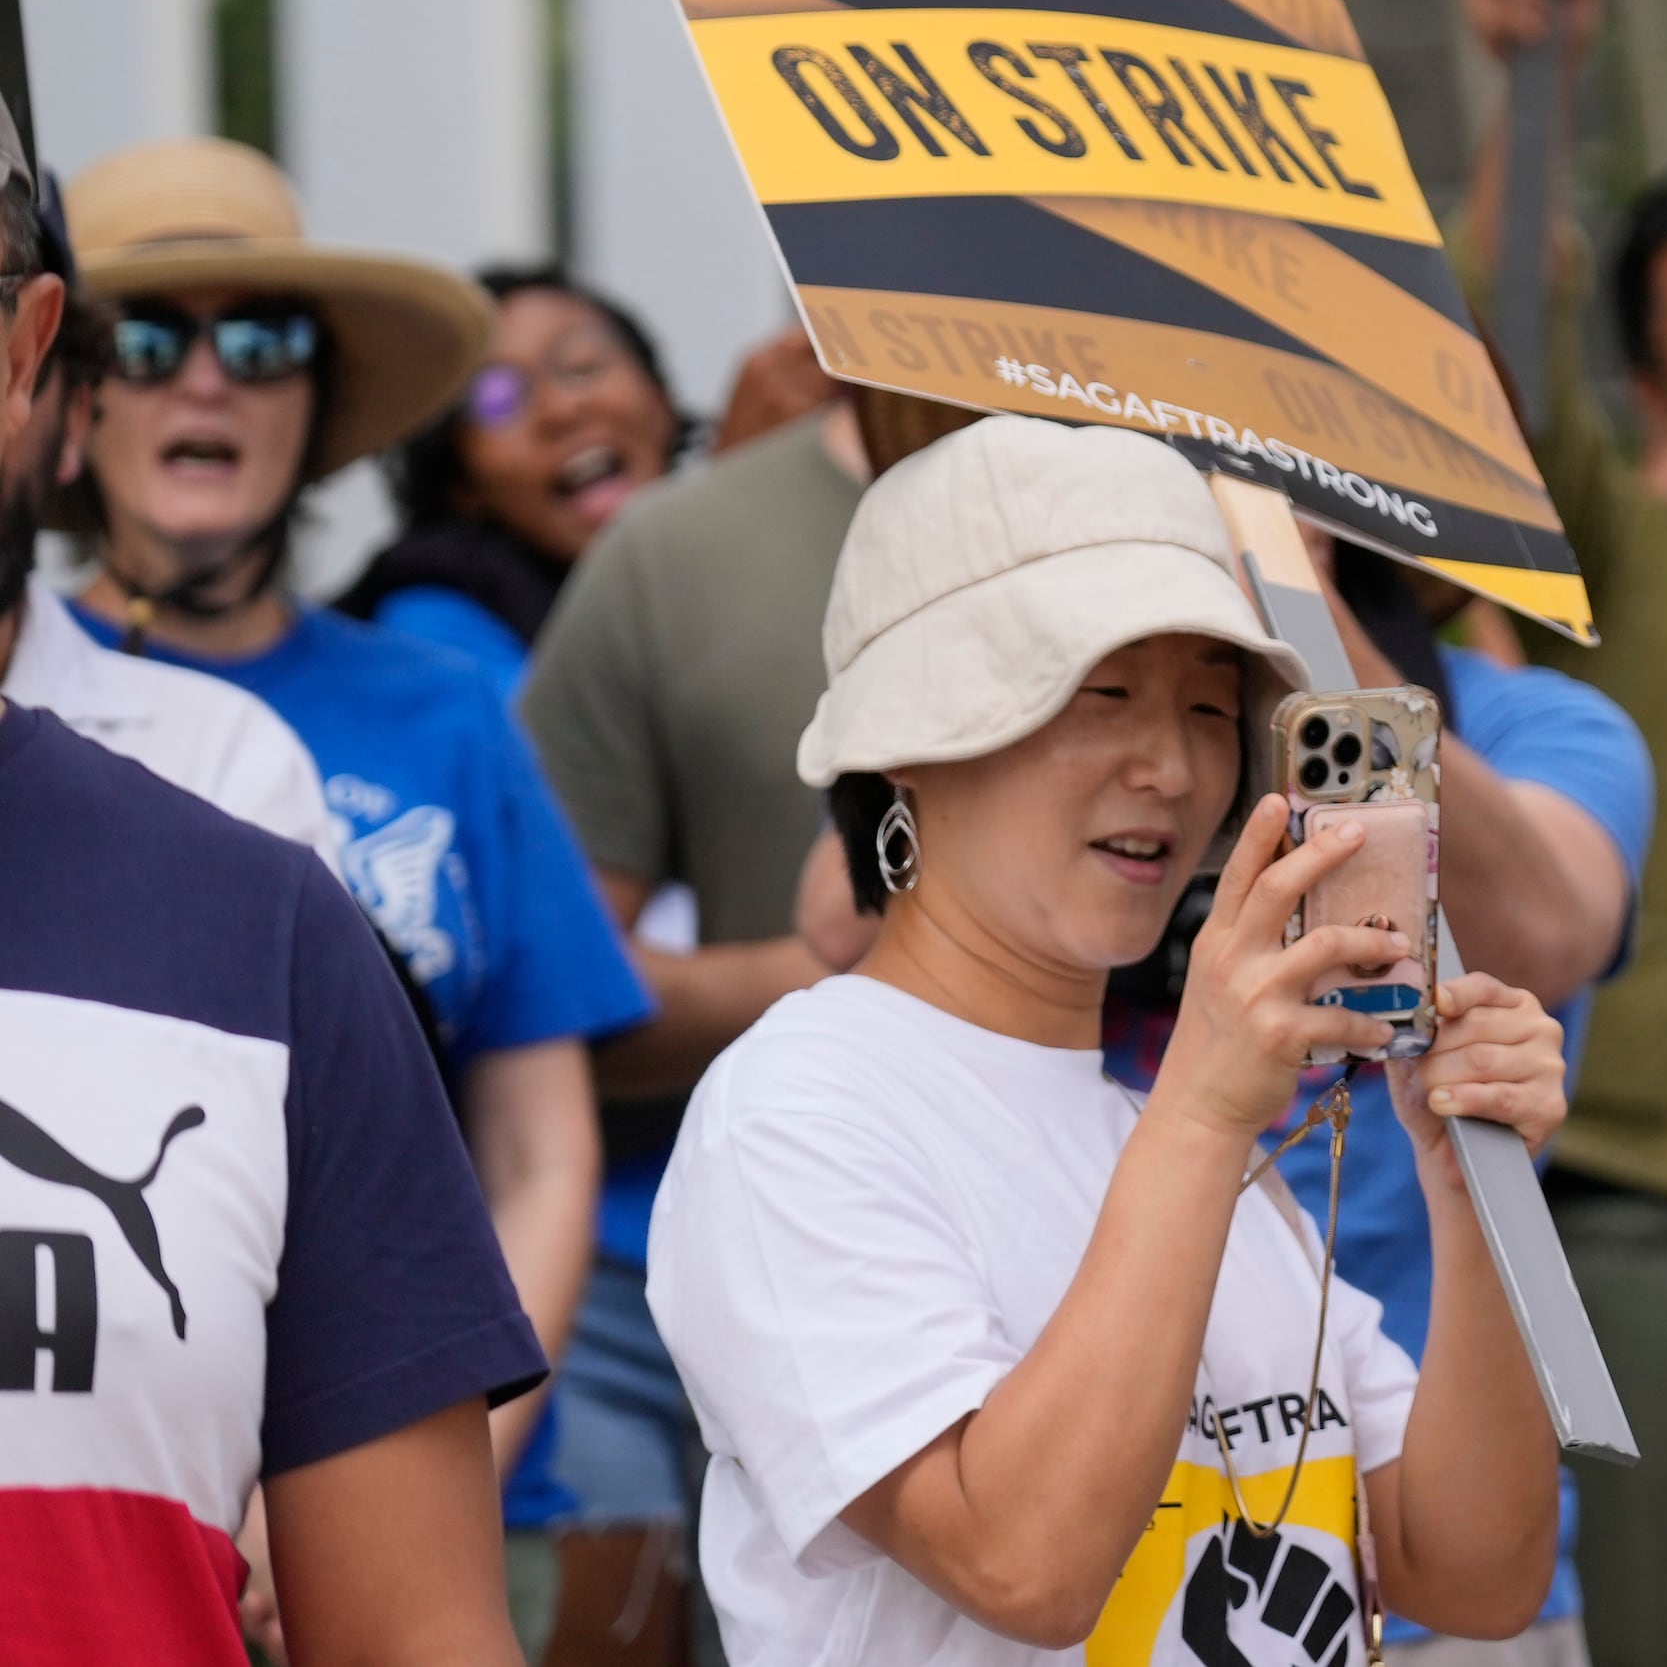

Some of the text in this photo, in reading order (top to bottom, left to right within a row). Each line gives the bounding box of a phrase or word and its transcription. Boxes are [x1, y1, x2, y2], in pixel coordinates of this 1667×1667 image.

[771, 39, 1383, 203] ON STRIKE
[868, 307, 1106, 382] STRIKE
[994, 354, 1439, 538] #SAGAFTRASTRONG
